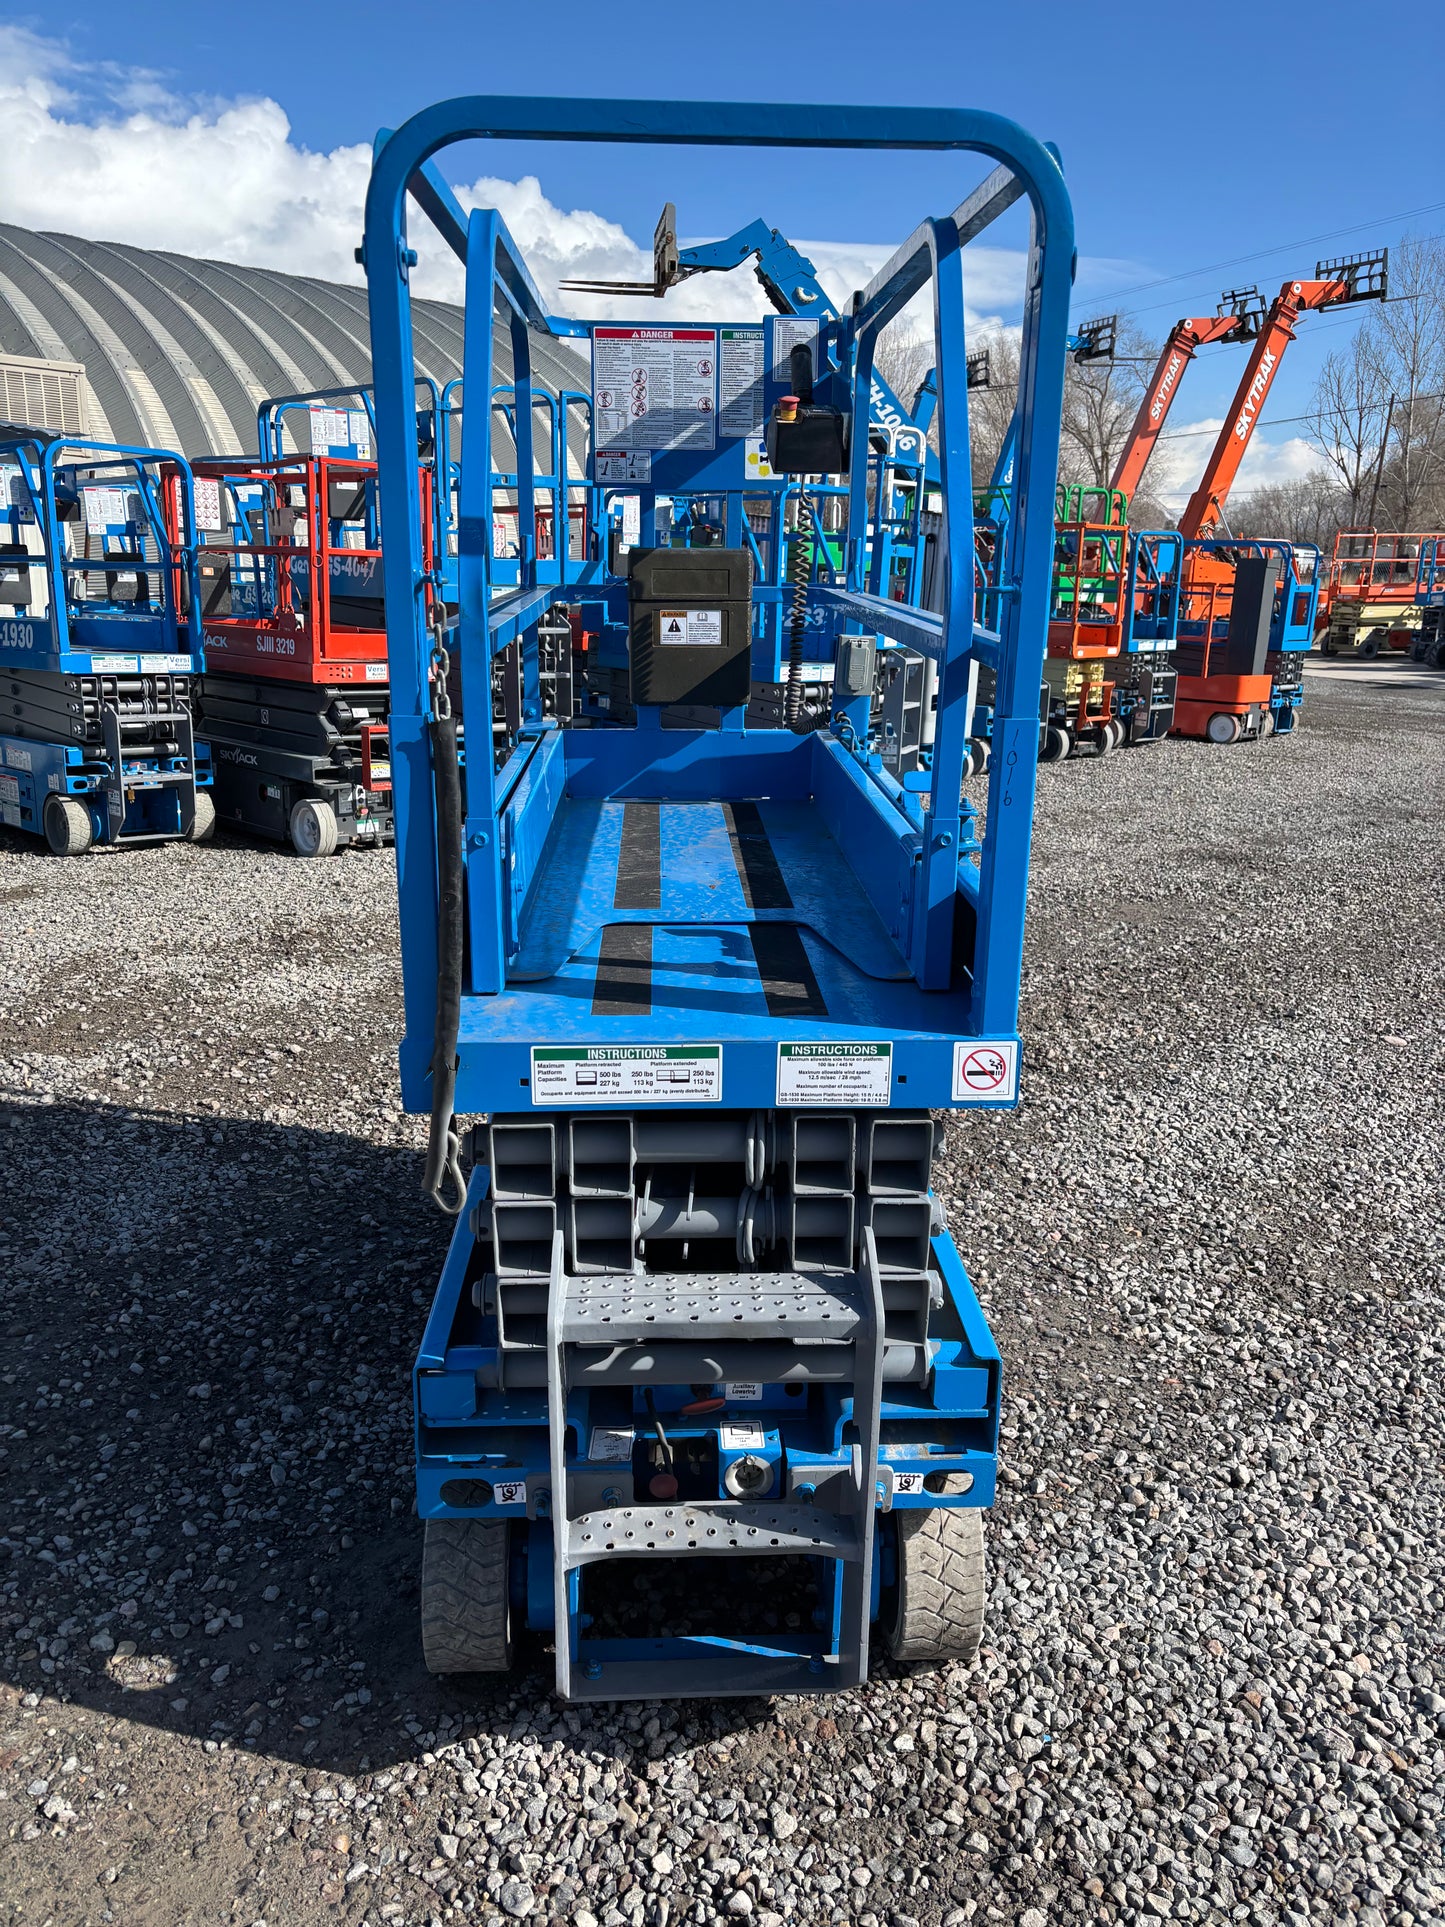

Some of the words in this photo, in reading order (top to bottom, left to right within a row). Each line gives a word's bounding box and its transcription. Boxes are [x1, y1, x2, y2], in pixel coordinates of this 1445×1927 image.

[641, 331, 674, 339] DANGER
[1151, 353, 1182, 421] SKYTRAK
[1235, 346, 1276, 441] SKYTRAK
[276, 638, 295, 656] 3219
[219, 747, 258, 766] SKYJACK
[587, 1048, 667, 1060] INSTRUCTIONS
[791, 1045, 878, 1055] INSTRUCTIONS
